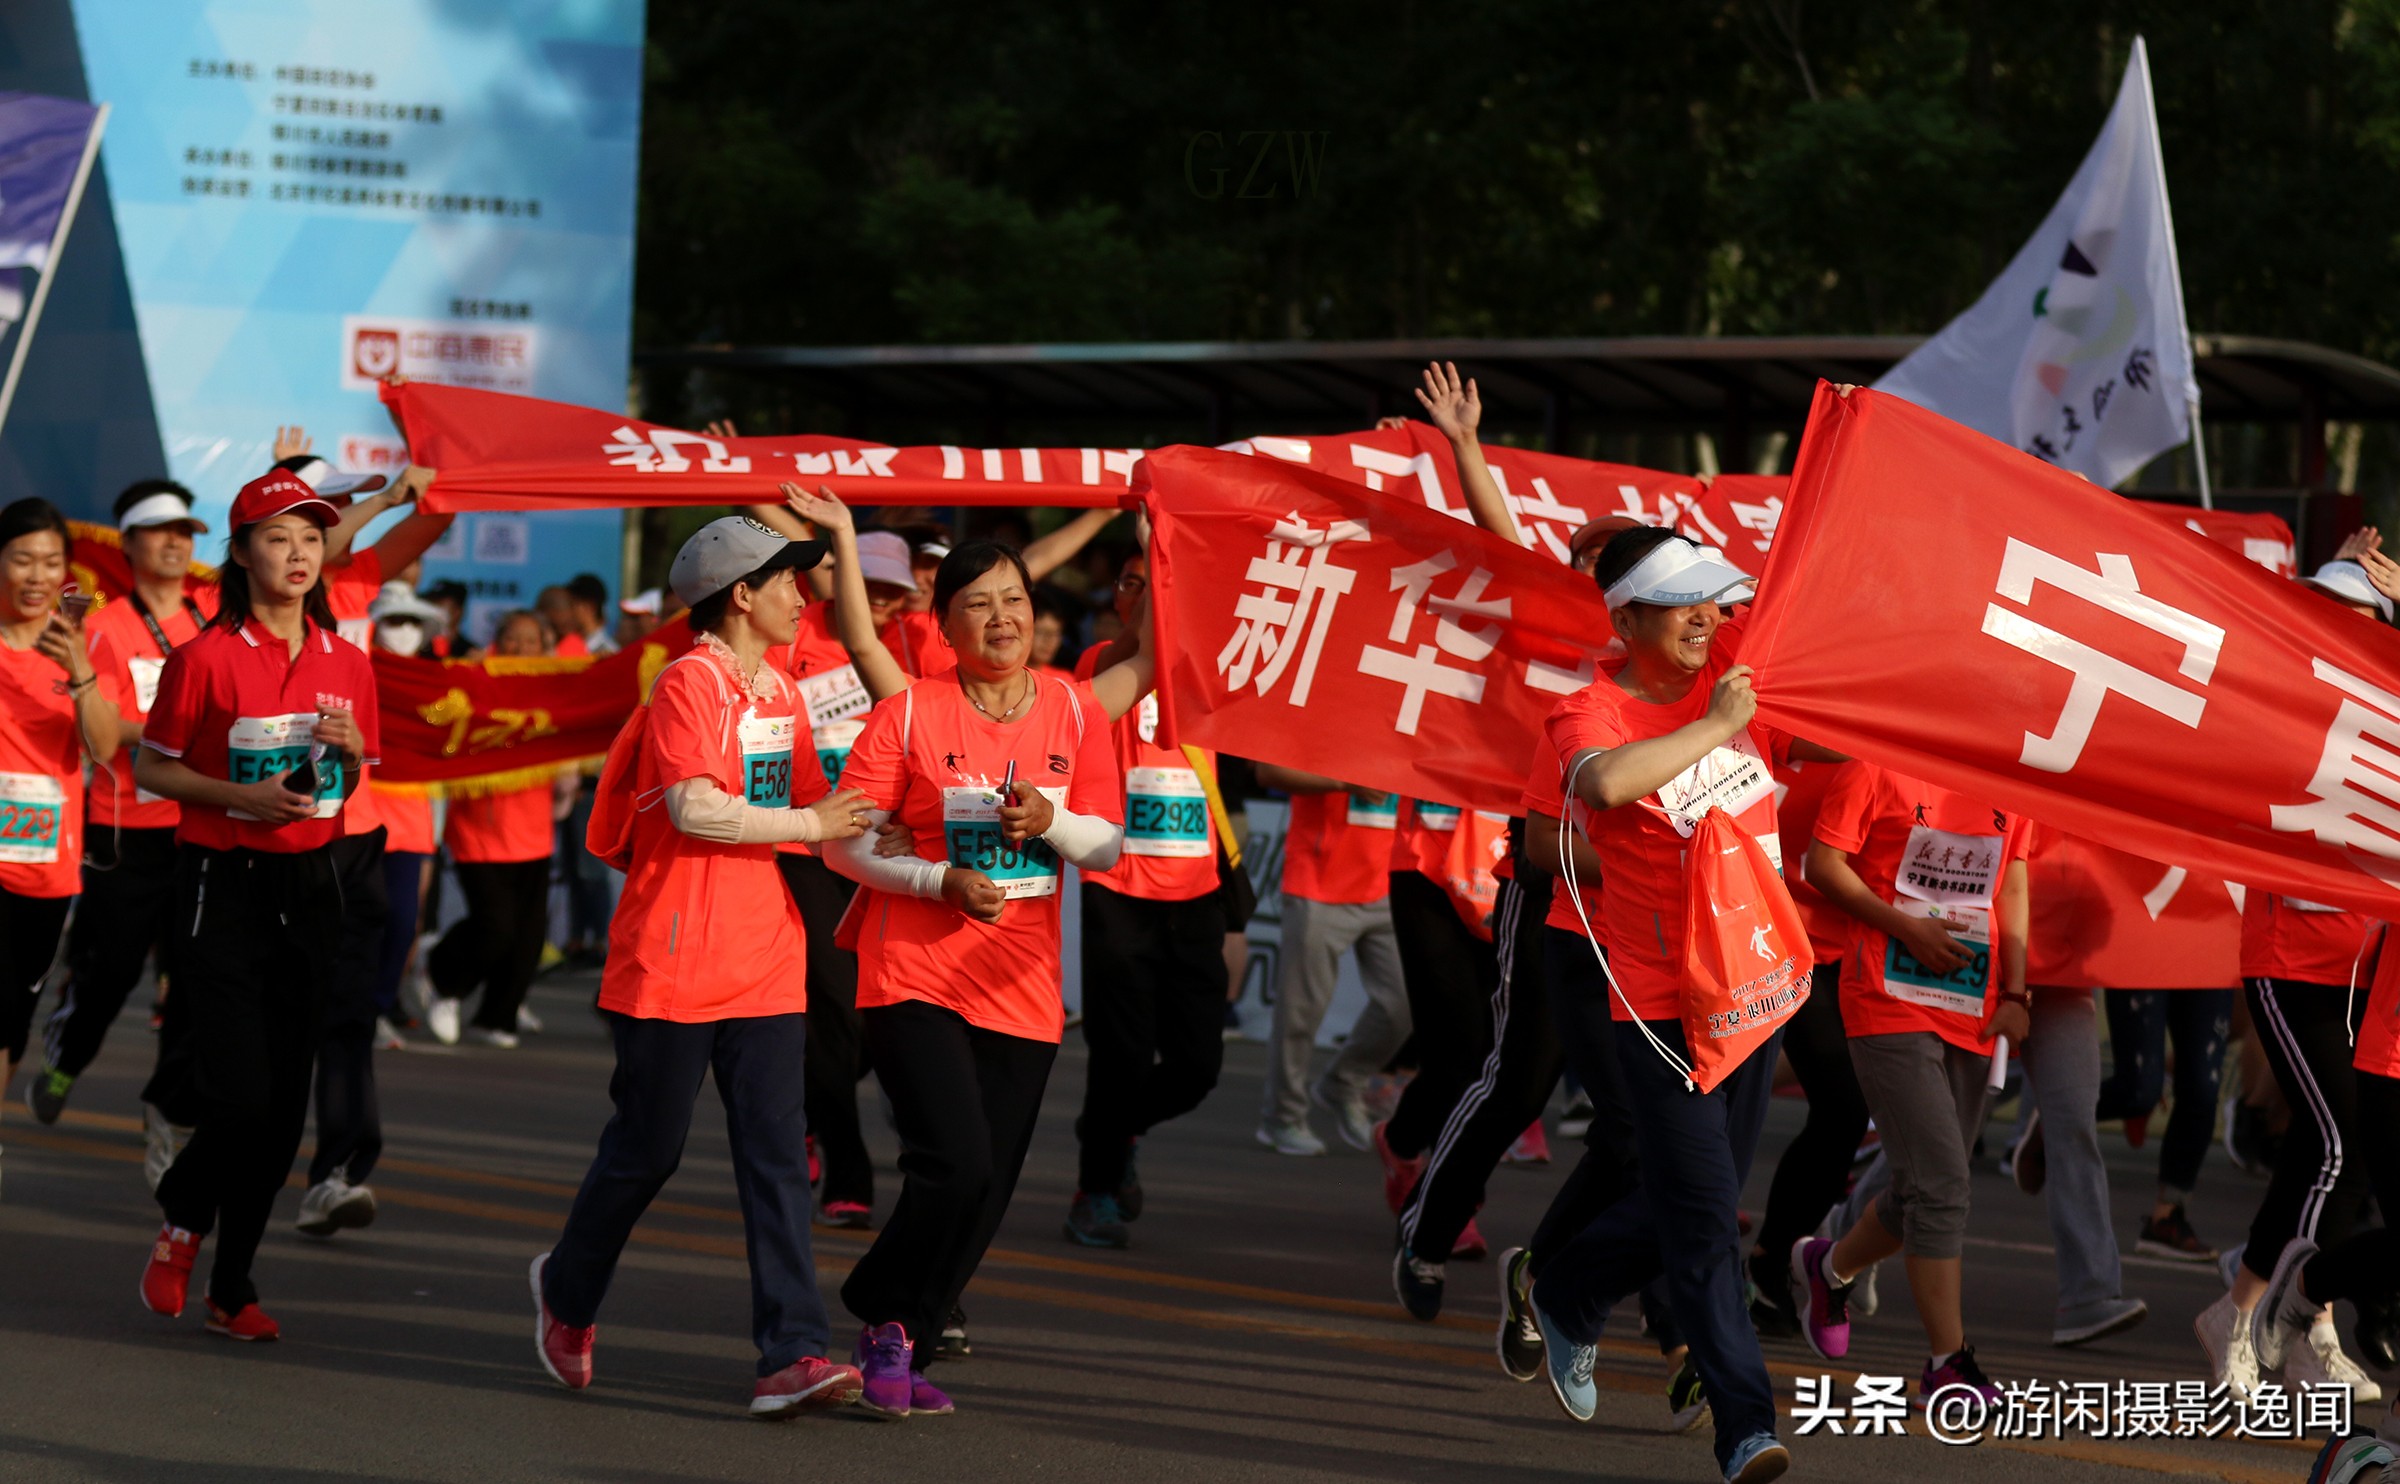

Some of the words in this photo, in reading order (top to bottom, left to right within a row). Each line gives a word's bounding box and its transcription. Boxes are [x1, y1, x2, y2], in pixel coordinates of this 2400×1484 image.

[1217, 510, 1596, 735] 新华
[236, 753, 337, 792] E62
[750, 758, 791, 803] E58
[0, 805, 55, 841] 229
[1131, 799, 1206, 833] E2928
[1915, 840, 1993, 869] 新华书店
[1907, 872, 1986, 895] 宁夏新华书店集团
